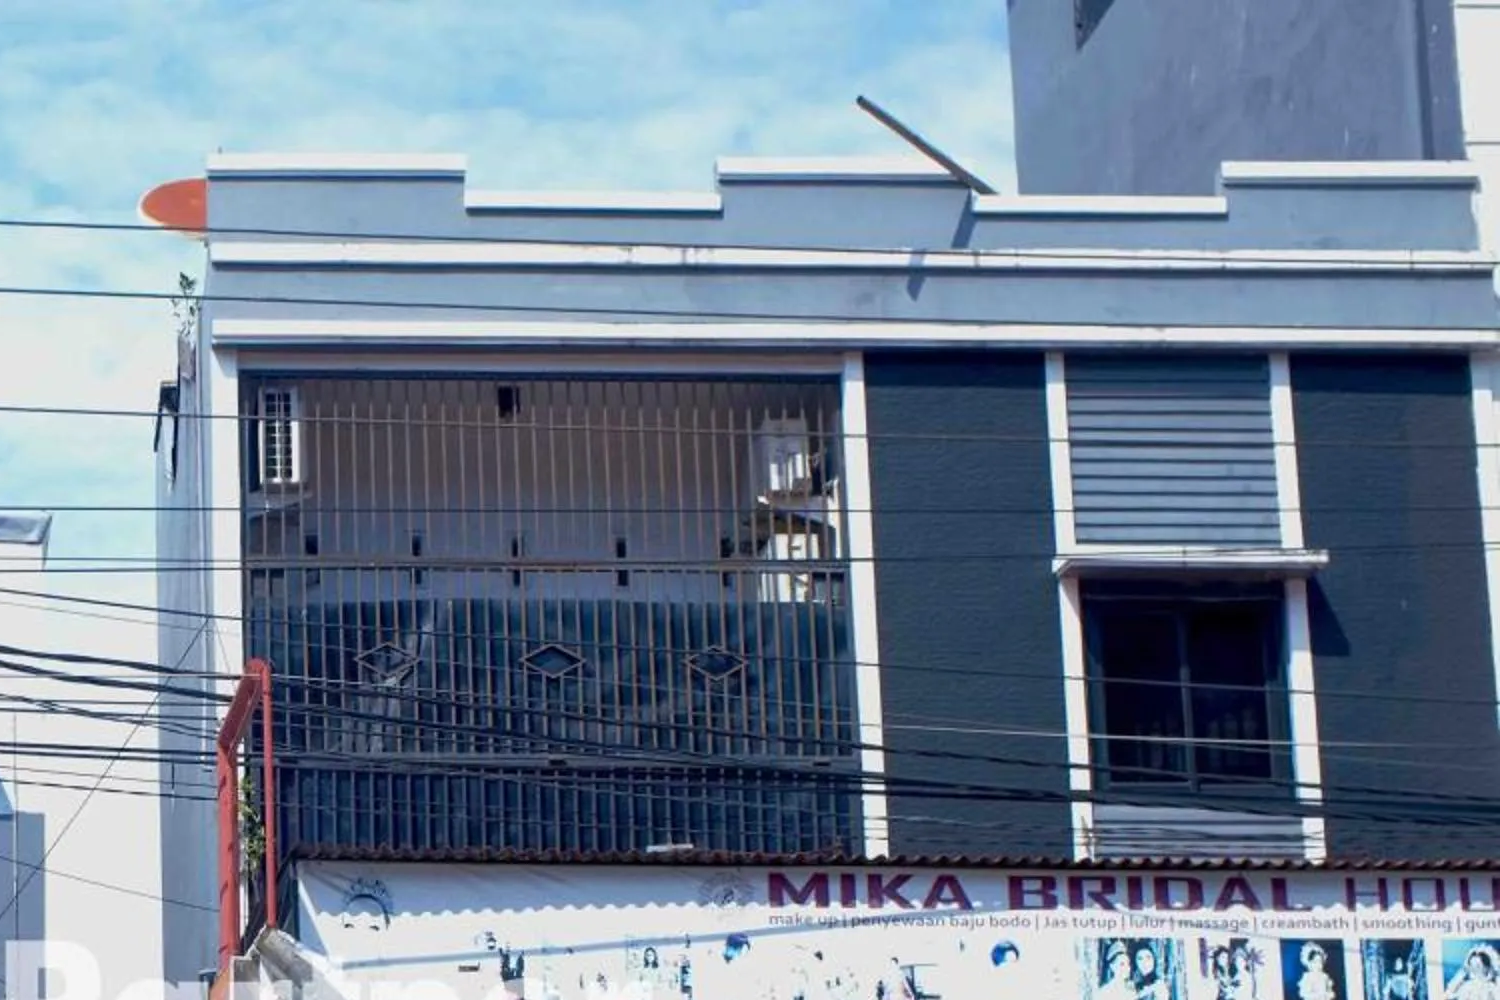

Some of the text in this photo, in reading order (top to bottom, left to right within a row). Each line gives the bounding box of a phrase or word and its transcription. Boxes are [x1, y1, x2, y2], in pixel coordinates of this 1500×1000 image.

[767, 872, 974, 911] MIKA
[1008, 875, 1313, 912] BRIDAL
[768, 912, 813, 926] make
[851, 913, 945, 930] penyewaan
[949, 914, 985, 930] baju
[989, 915, 1032, 929] bodo
[1072, 916, 1117, 930] tutup
[1178, 917, 1249, 932] massage
[1261, 915, 1349, 930] creambath
[1362, 916, 1452, 933] smoothing
